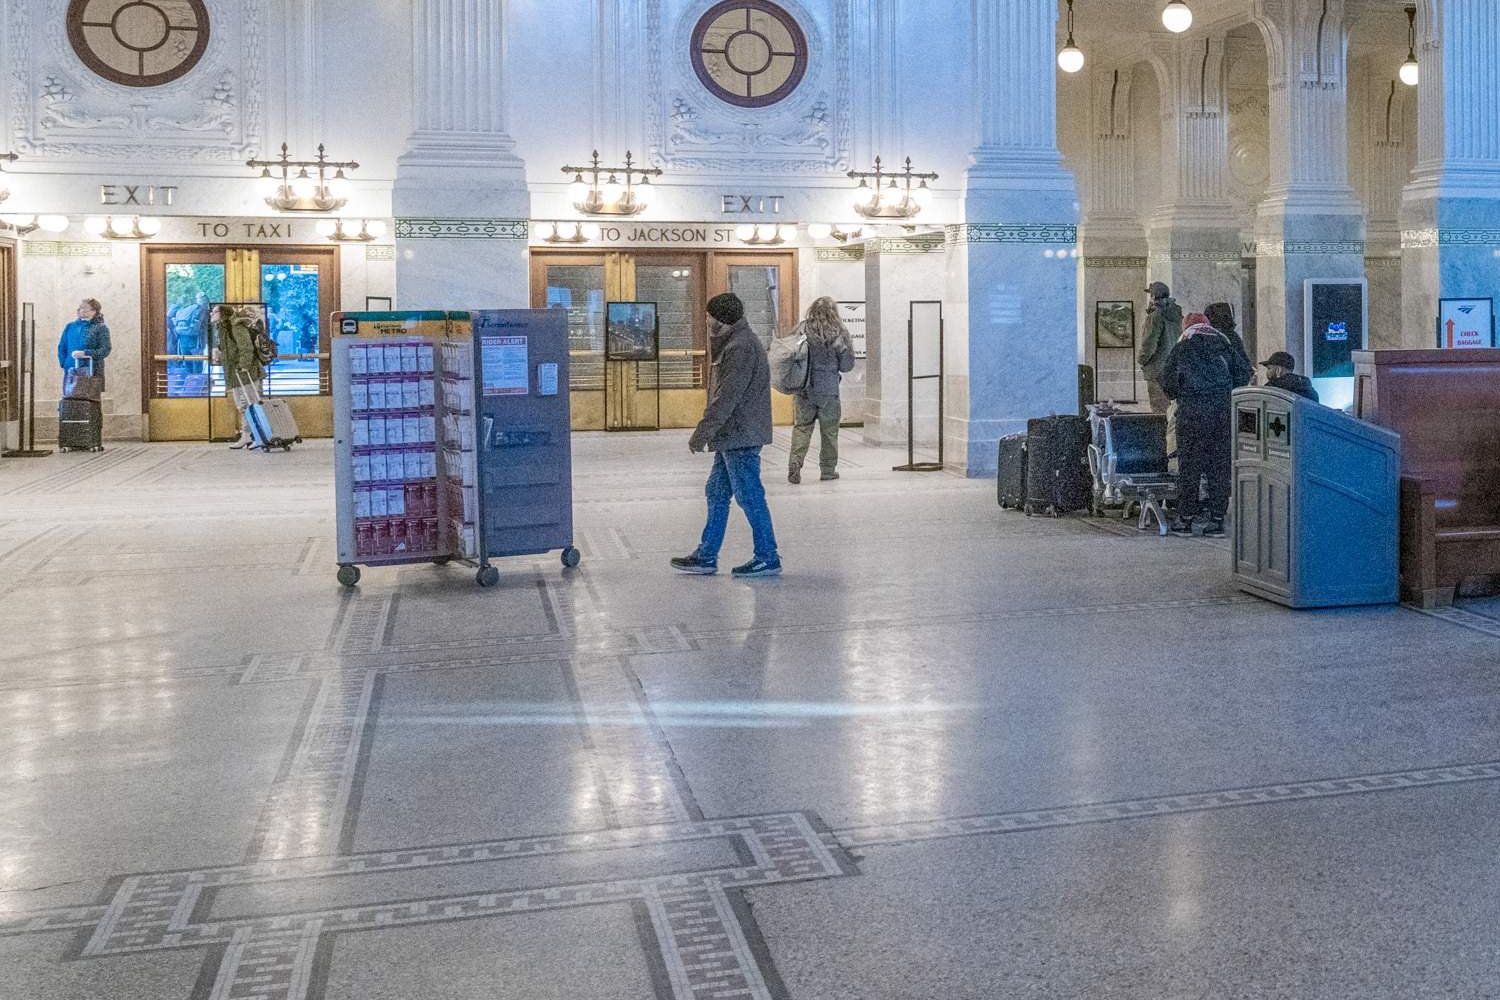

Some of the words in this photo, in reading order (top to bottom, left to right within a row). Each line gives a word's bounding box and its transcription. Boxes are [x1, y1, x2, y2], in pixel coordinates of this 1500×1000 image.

[101, 184, 178, 206] EXIT
[721, 195, 785, 214] EXIT
[197, 223, 229, 238] TO
[243, 223, 292, 238] TAXI
[600, 228, 621, 242] TO
[627, 228, 706, 242] JACKSON
[713, 229, 734, 242] ST
